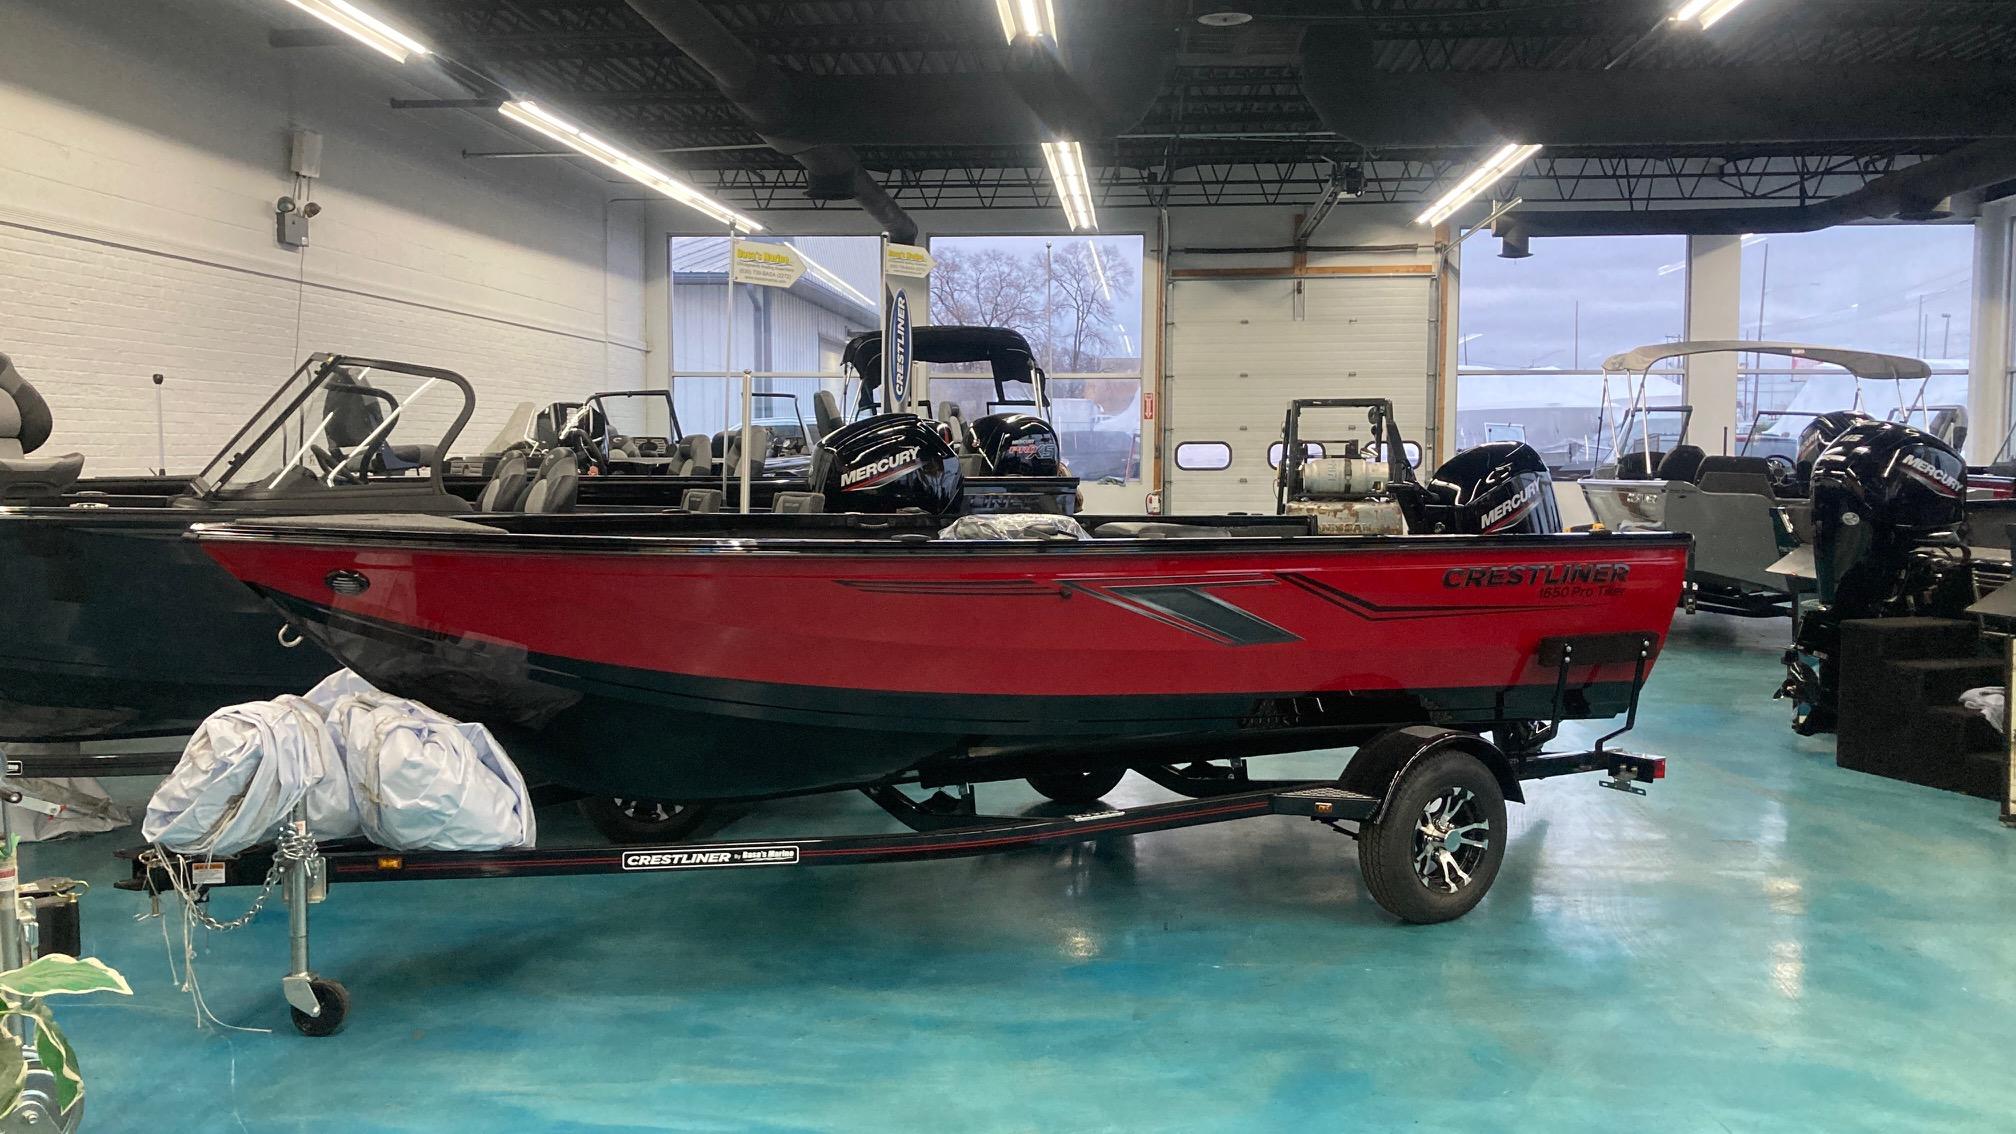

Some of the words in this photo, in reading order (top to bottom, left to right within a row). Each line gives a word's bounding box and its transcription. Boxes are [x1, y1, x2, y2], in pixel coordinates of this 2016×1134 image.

[896, 297, 905, 396] CRESTLINER
[841, 446, 920, 488] MERCURY
[1902, 454, 1964, 492] MERCURY
[1481, 476, 1540, 530] MERCURY
[1443, 563, 1630, 589] CRESTLINER
[1572, 586, 1593, 598] Pro
[627, 852, 731, 866] CRESTLINER
